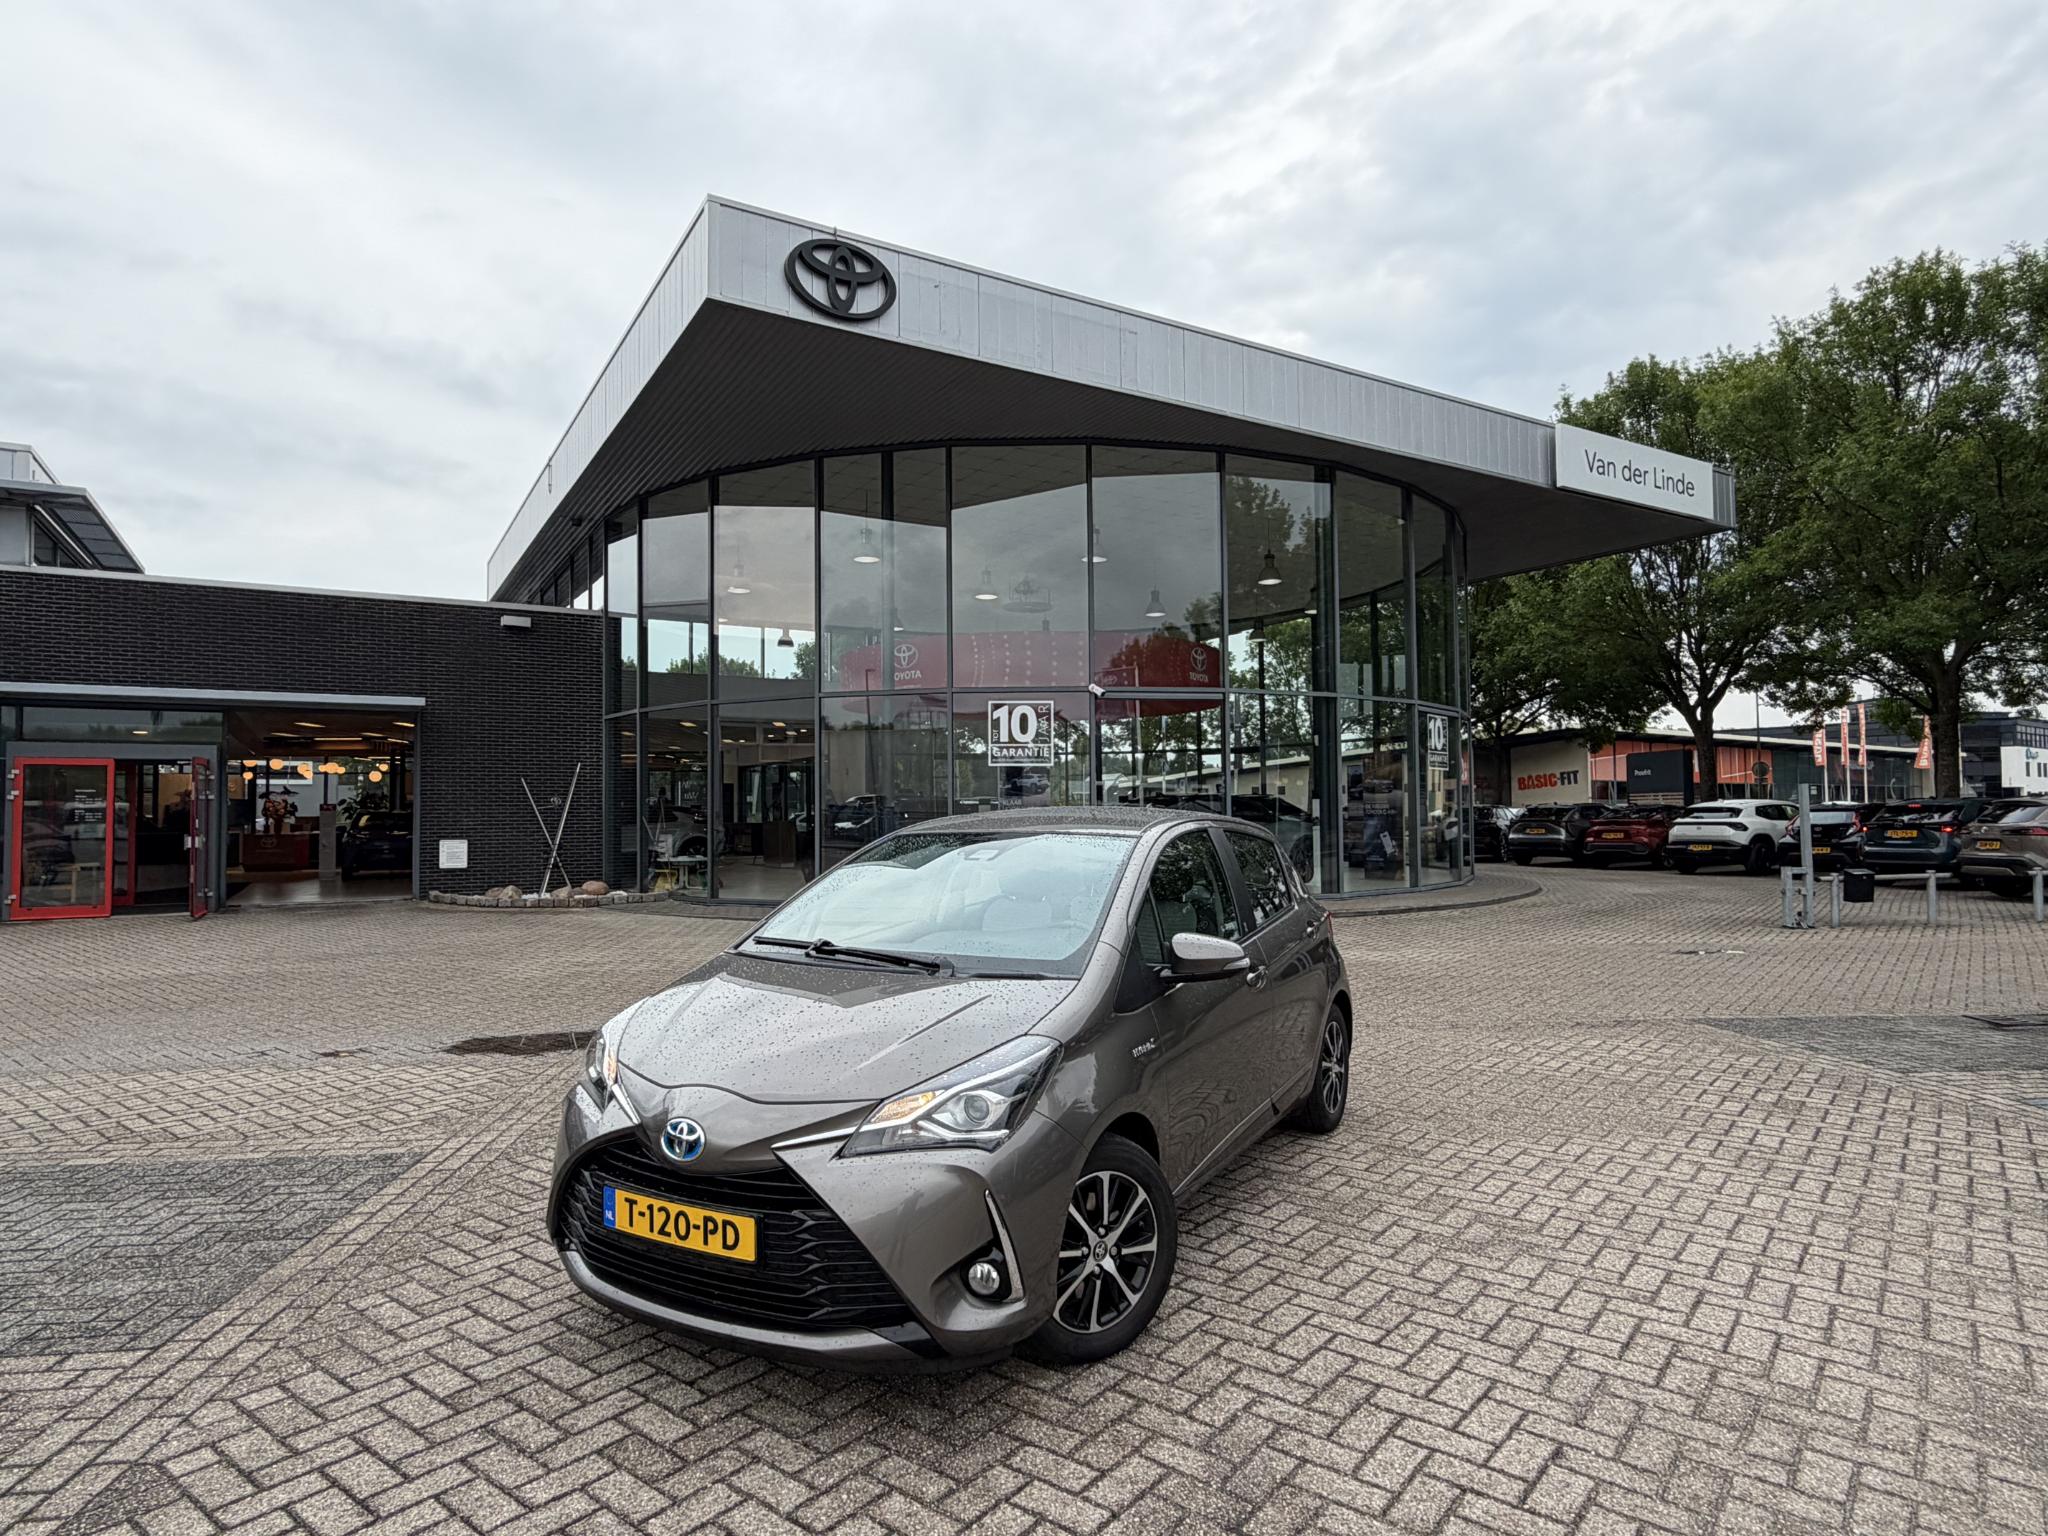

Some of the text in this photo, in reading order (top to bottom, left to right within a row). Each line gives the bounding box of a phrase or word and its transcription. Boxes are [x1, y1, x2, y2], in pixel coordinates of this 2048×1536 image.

[1585, 449, 1695, 497] Van der Linde
[992, 704, 1038, 743] 10
[1429, 718, 1443, 750] 10
[992, 746, 1050, 757] GARANTIE
[1517, 770, 1580, 791] BASIC-FIT
[605, 1210, 614, 1221] NL
[624, 1196, 740, 1251] T-120-PD
